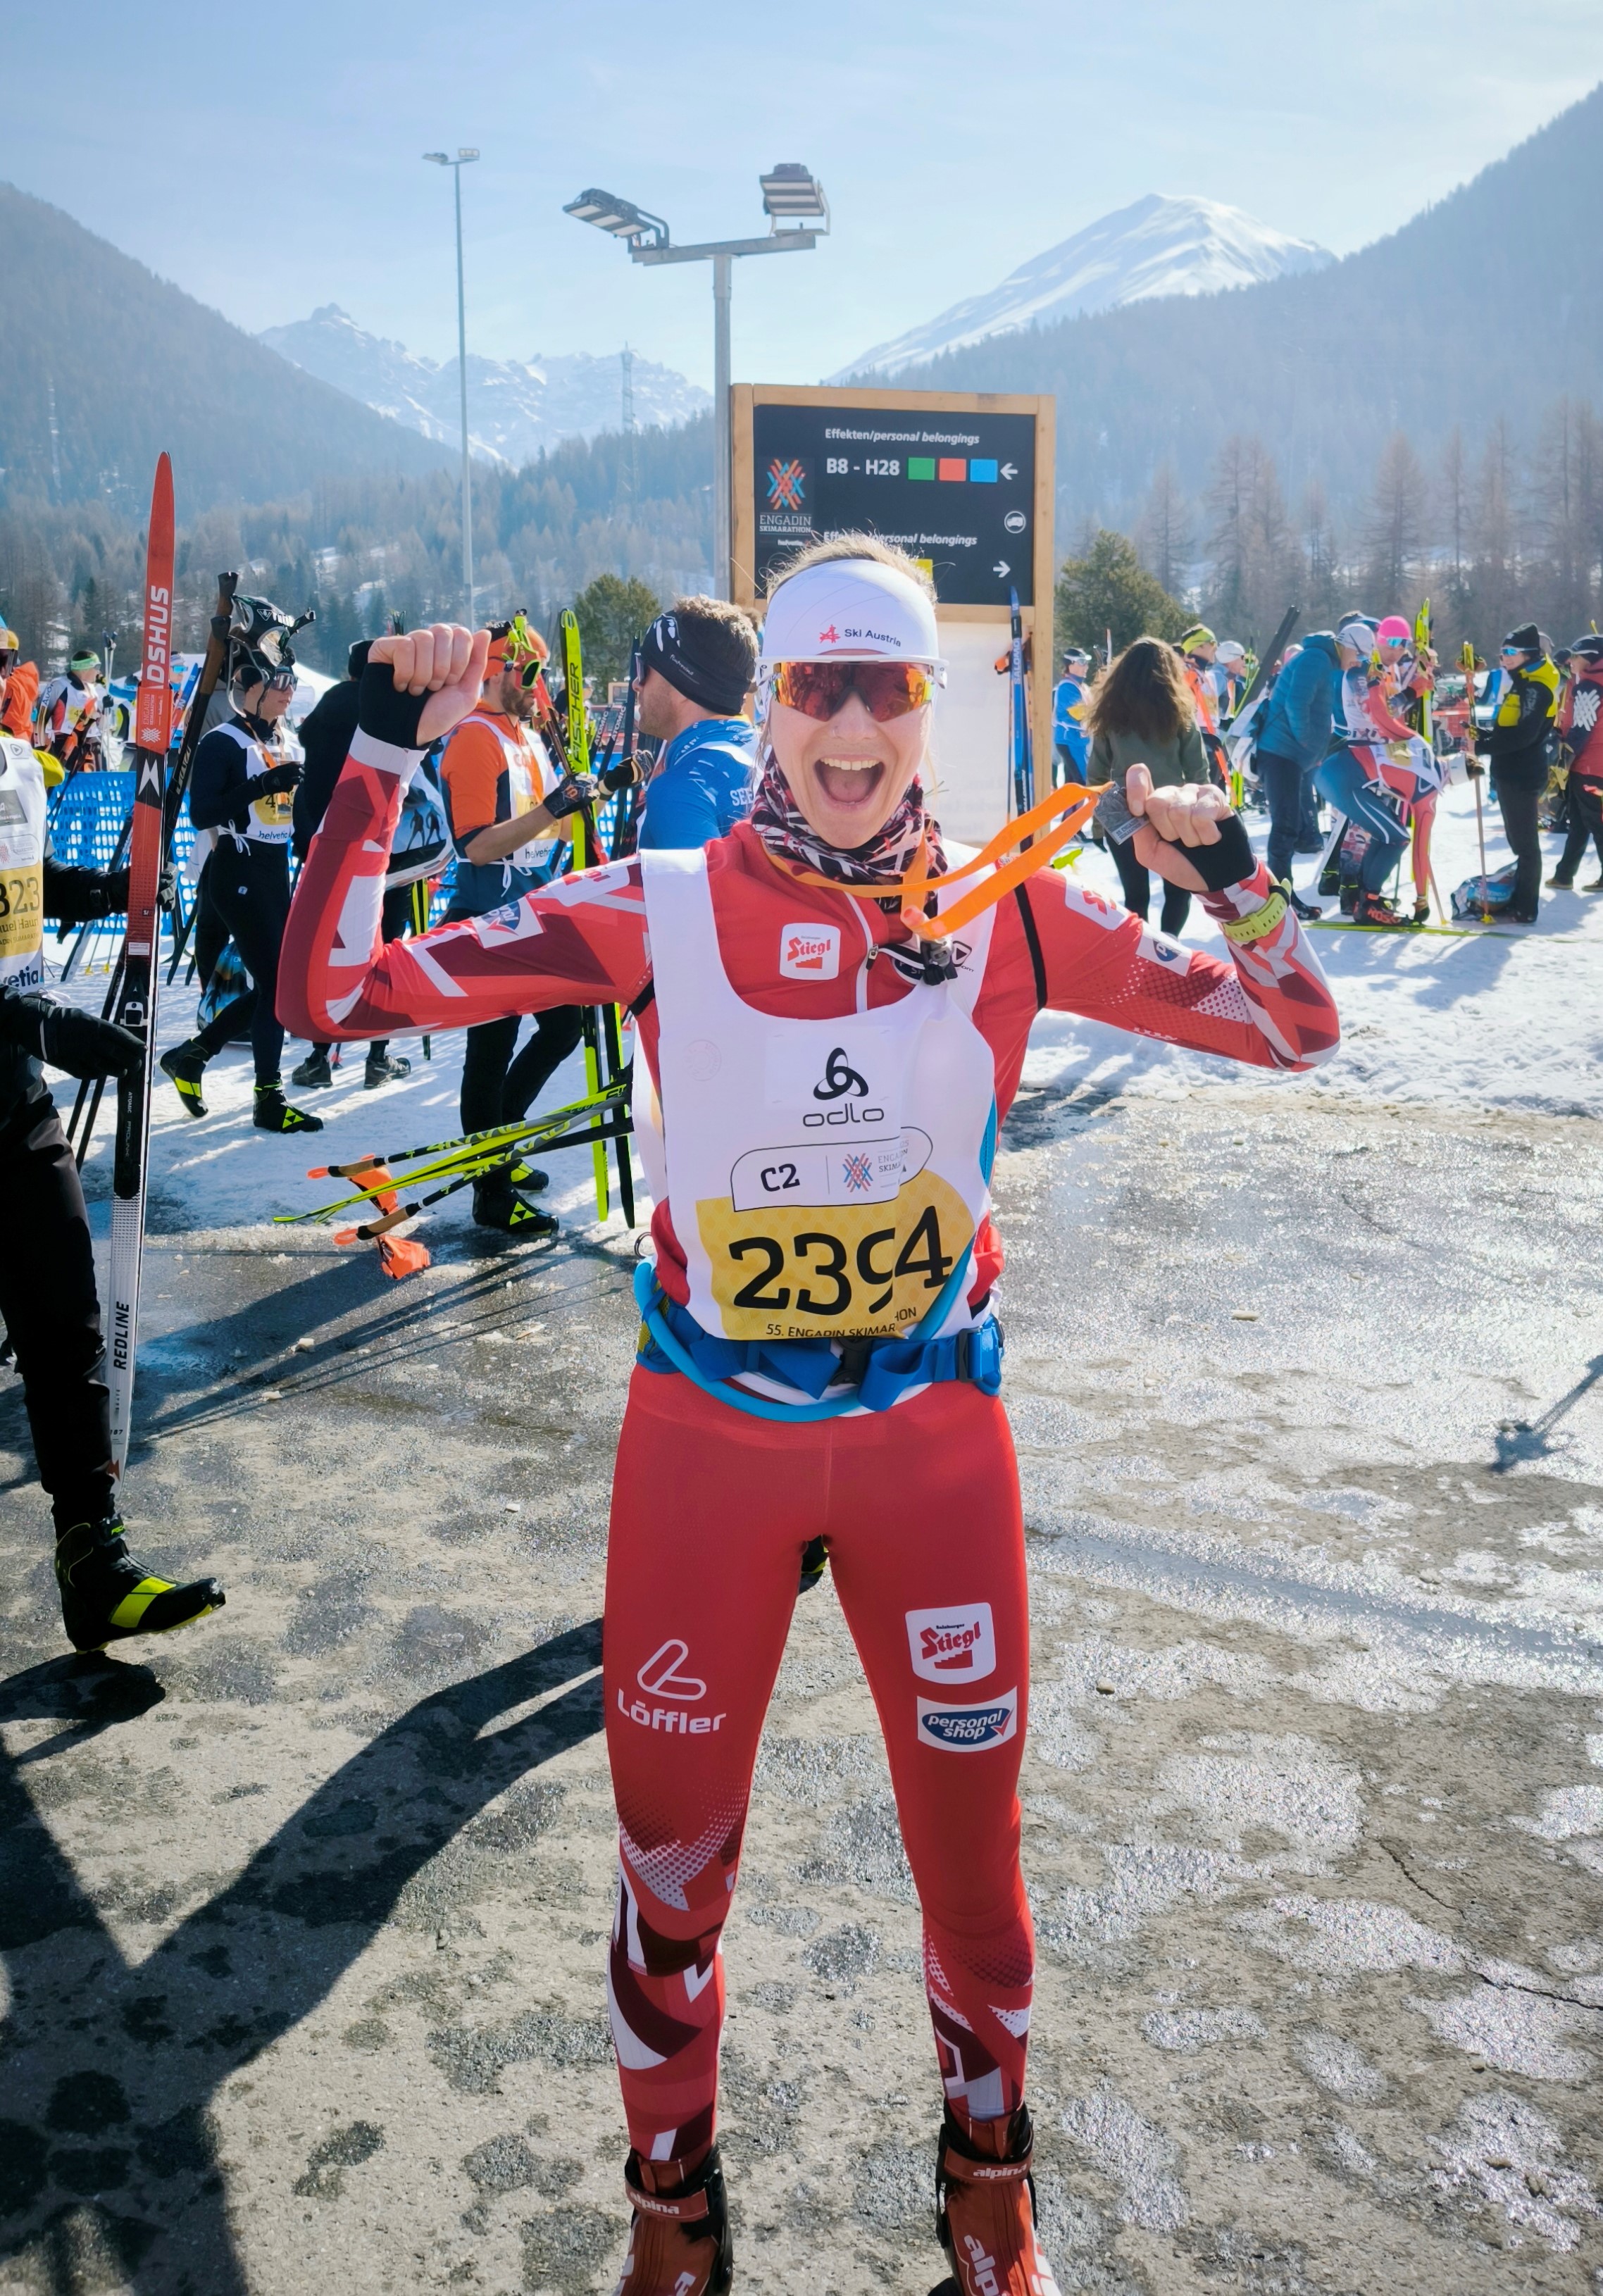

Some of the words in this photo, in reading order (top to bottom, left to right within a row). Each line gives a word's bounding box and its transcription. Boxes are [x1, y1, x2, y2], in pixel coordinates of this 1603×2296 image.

[825, 428, 920, 442] Effekten/personal
[921, 431, 980, 446] belongings
[826, 458, 849, 475] B8
[866, 459, 900, 476] H28
[759, 515, 811, 526] ENGADIN
[920, 532, 978, 547] belongings
[844, 628, 861, 637] Ski
[865, 630, 902, 647] Austria
[569, 662, 582, 764] FISCHER
[611, 705, 627, 742] ATOMIC
[594, 710, 610, 747] ATOMIC
[787, 937, 831, 961] Stiegl
[802, 1103, 885, 1128] odlo
[760, 1163, 801, 1192] C2
[728, 1205, 954, 1316] 2394
[113, 1302, 130, 1370] REDLINE
[766, 1323, 785, 1337] 55.
[919, 1621, 981, 1660] Stiegl
[928, 1709, 1003, 1729] personal
[942, 1726, 985, 1740] shop
[973, 2163, 1028, 2180] alpina
[630, 2191, 680, 2215] alpina
